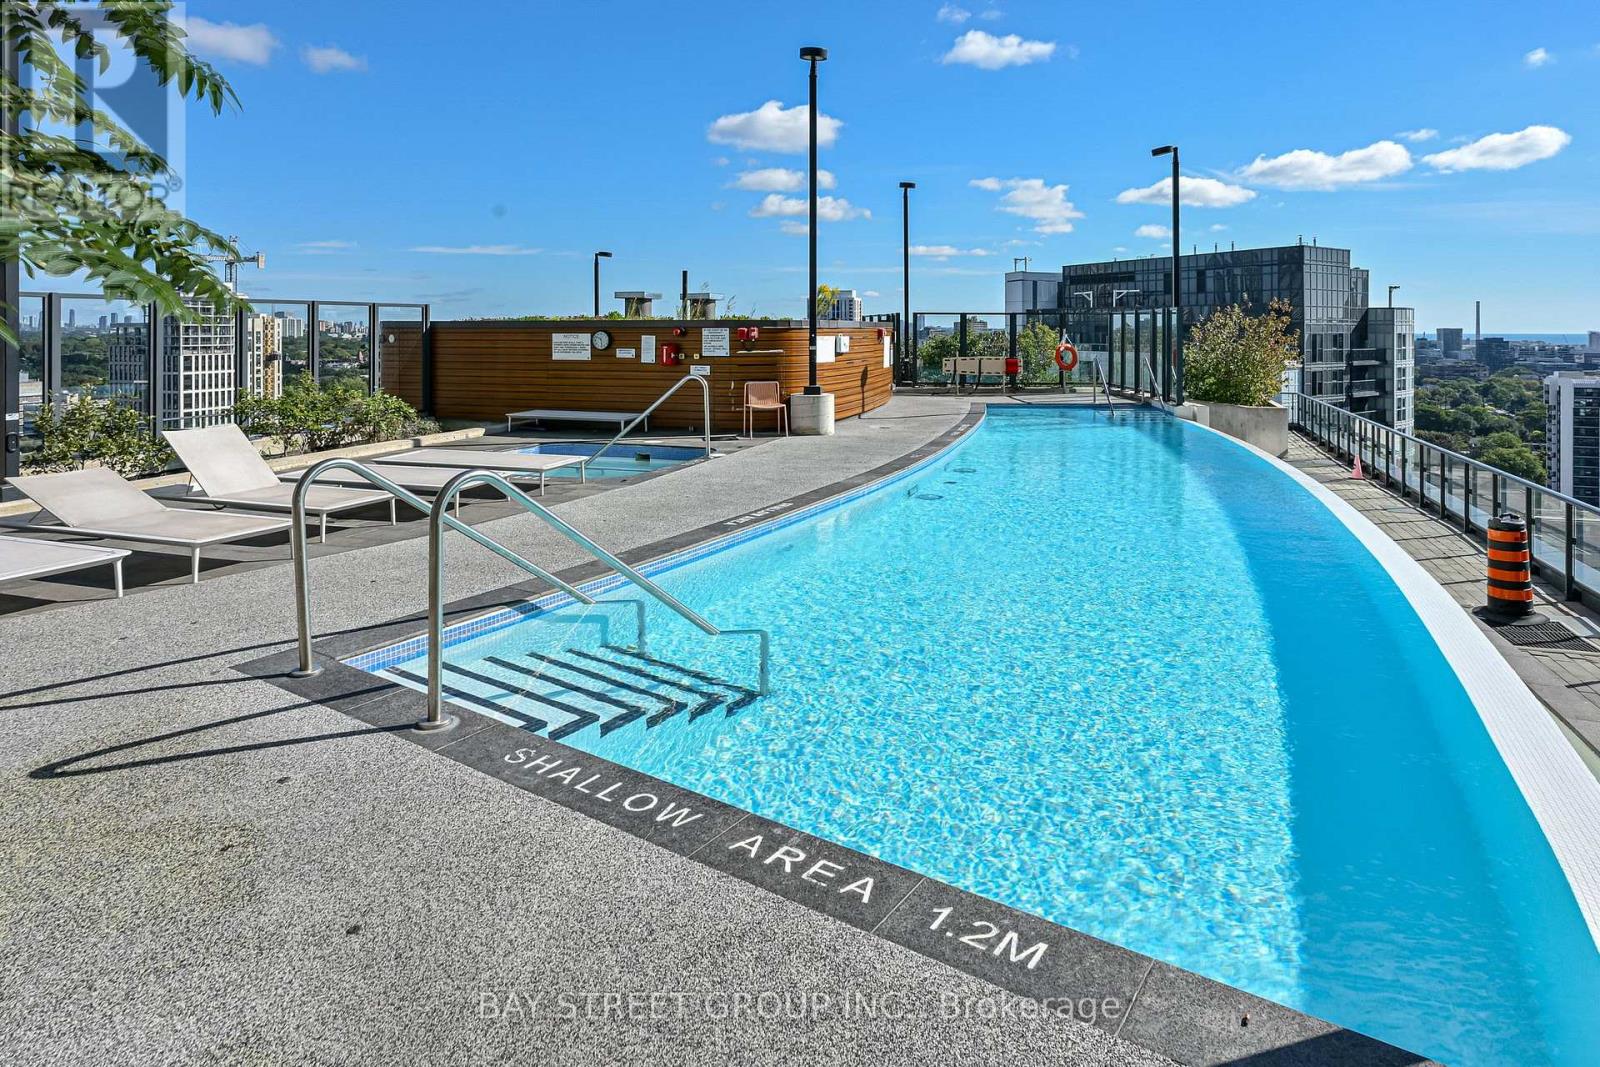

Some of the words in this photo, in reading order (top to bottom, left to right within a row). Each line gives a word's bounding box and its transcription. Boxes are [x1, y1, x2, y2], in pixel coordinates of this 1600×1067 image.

[504, 748, 704, 828] SHALLOW
[728, 835, 874, 904] AREA
[930, 906, 1049, 970] 1.2M
